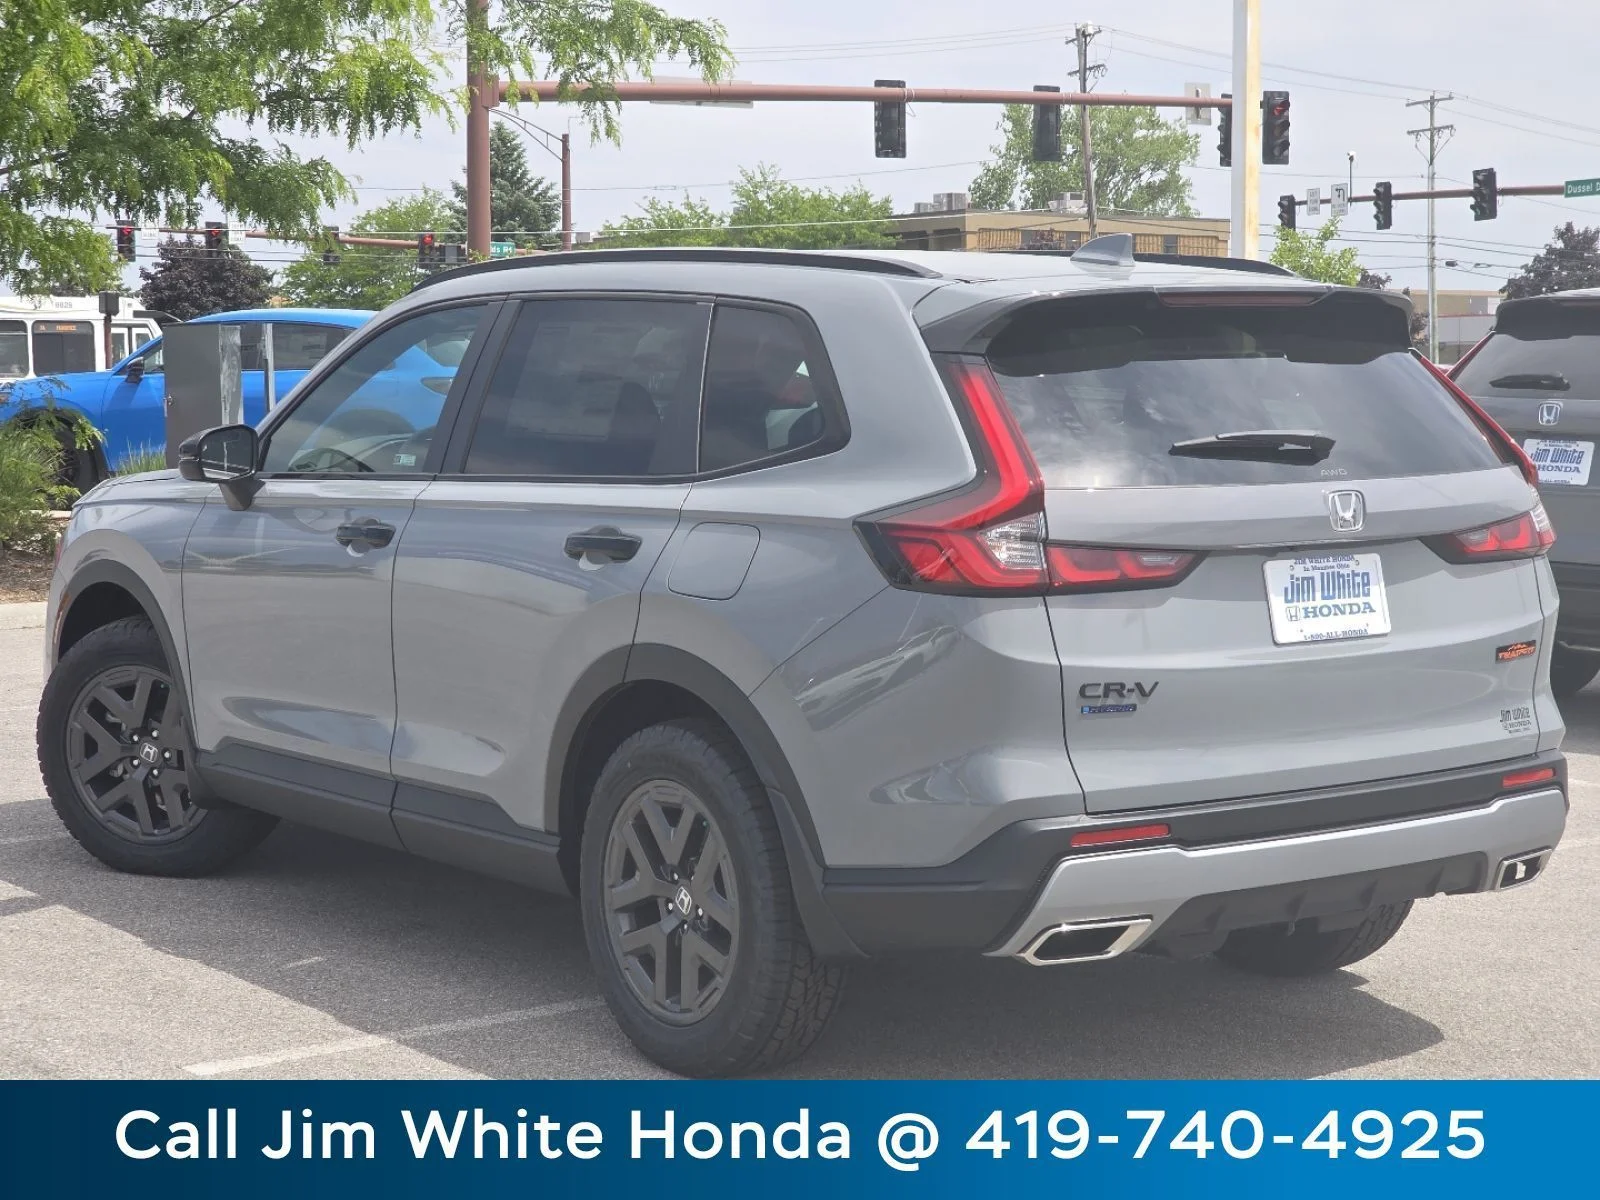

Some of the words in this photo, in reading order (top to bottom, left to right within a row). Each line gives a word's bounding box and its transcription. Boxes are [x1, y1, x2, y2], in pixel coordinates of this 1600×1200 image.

[1567, 182, 1593, 194] Dussel
[1550, 448, 1584, 464] White
[1320, 468, 1348, 477] AWD
[1537, 464, 1581, 473] HONDA
[1320, 570, 1370, 600] White
[1302, 602, 1376, 619] HONDA
[1079, 681, 1159, 698] CR-V
